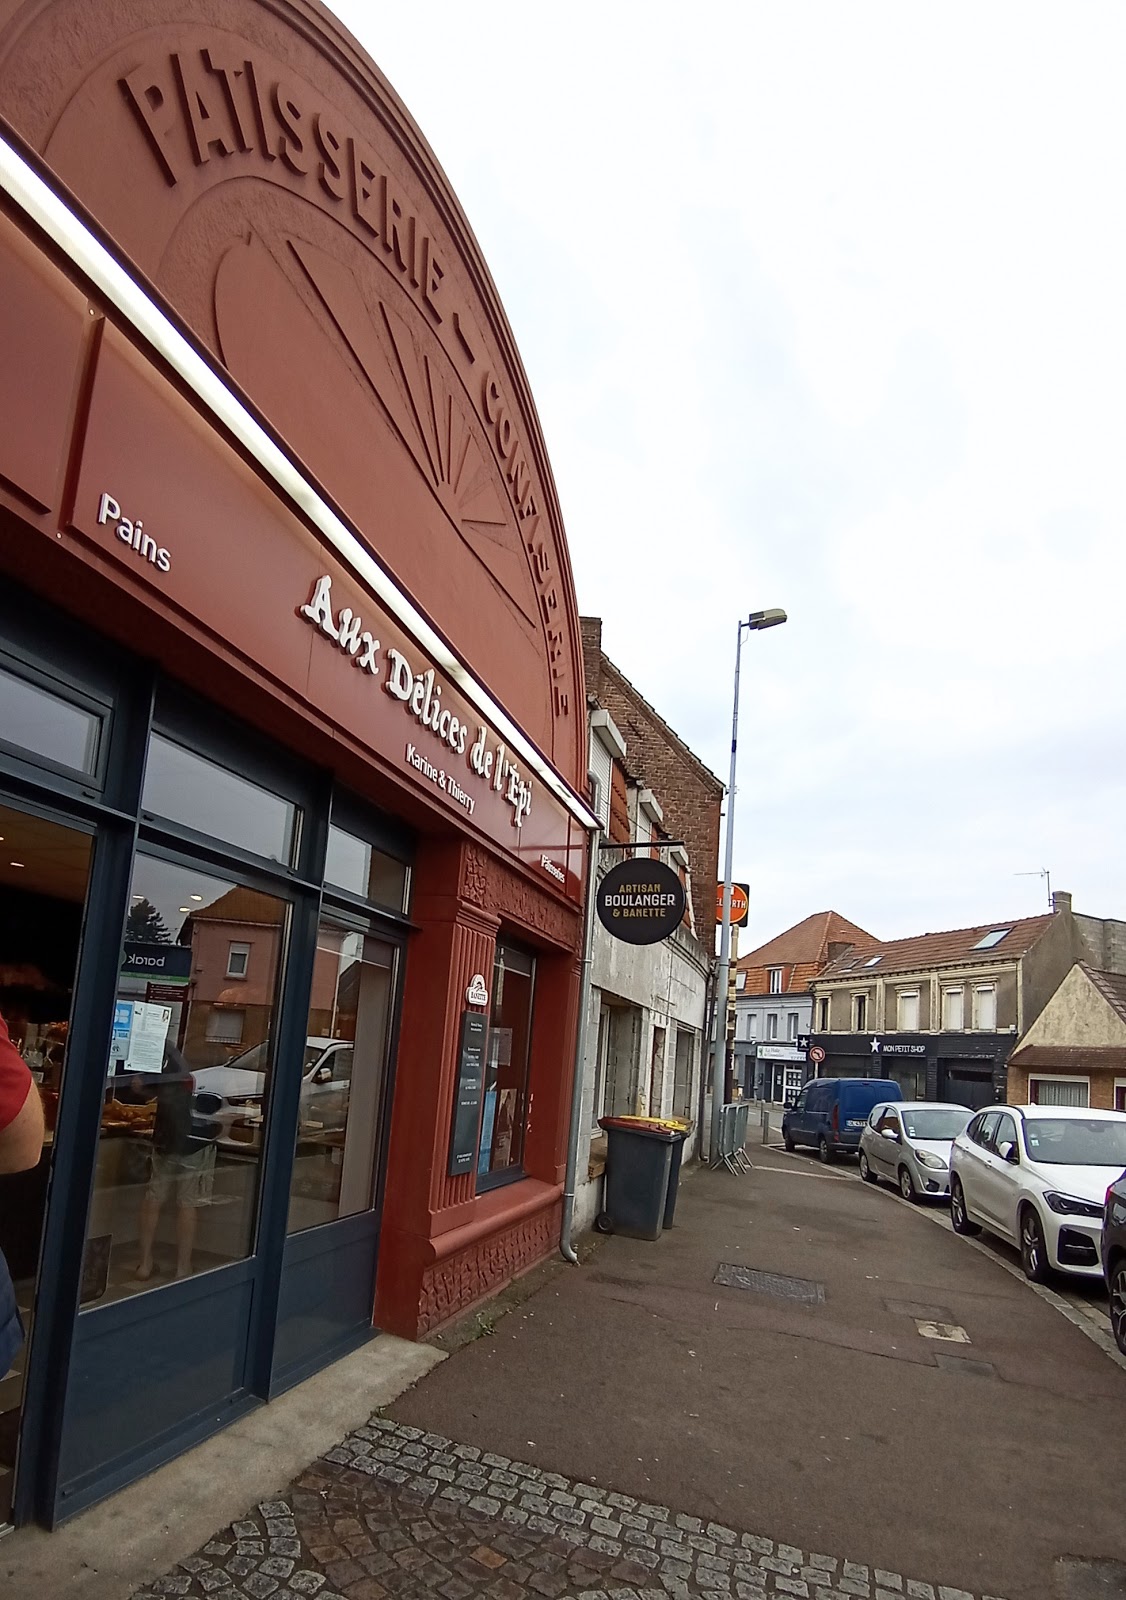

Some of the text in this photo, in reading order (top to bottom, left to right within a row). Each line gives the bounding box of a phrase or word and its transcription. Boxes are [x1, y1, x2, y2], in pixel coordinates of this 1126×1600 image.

[117, 48, 450, 325] PATISSERIE
[97, 492, 172, 573] Pains
[299, 574, 382, 676] Aux
[385, 648, 468, 754] Délices
[470, 726, 494, 781] de
[405, 743, 438, 781] Karine
[445, 775, 477, 815] Thierry
[604, 894, 676, 907] BOULANGER
[618, 884, 661, 894] ARTISAN
[612, 908, 667, 918] & BANETTE
[882, 1045, 926, 1053] MON PETIT SHOP
